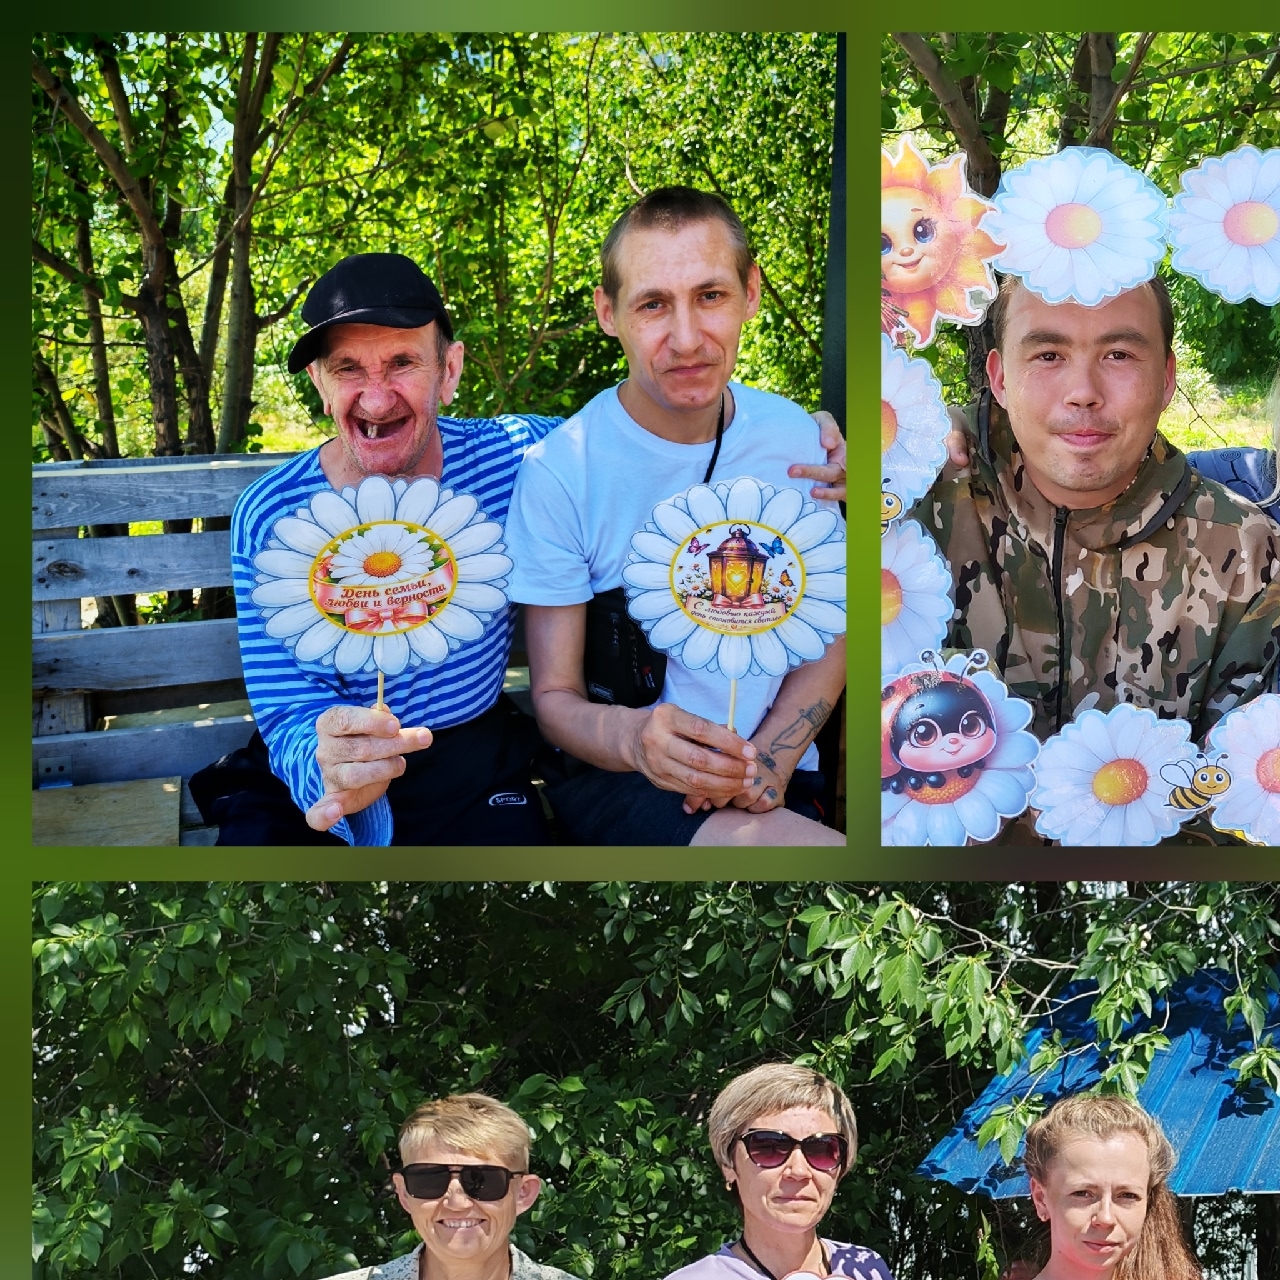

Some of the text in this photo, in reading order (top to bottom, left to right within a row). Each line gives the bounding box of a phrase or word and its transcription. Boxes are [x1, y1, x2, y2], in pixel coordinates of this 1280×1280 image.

[341, 579, 431, 598] День семьи,
[387, 584, 446, 605] верности
[691, 610, 706, 619] день
